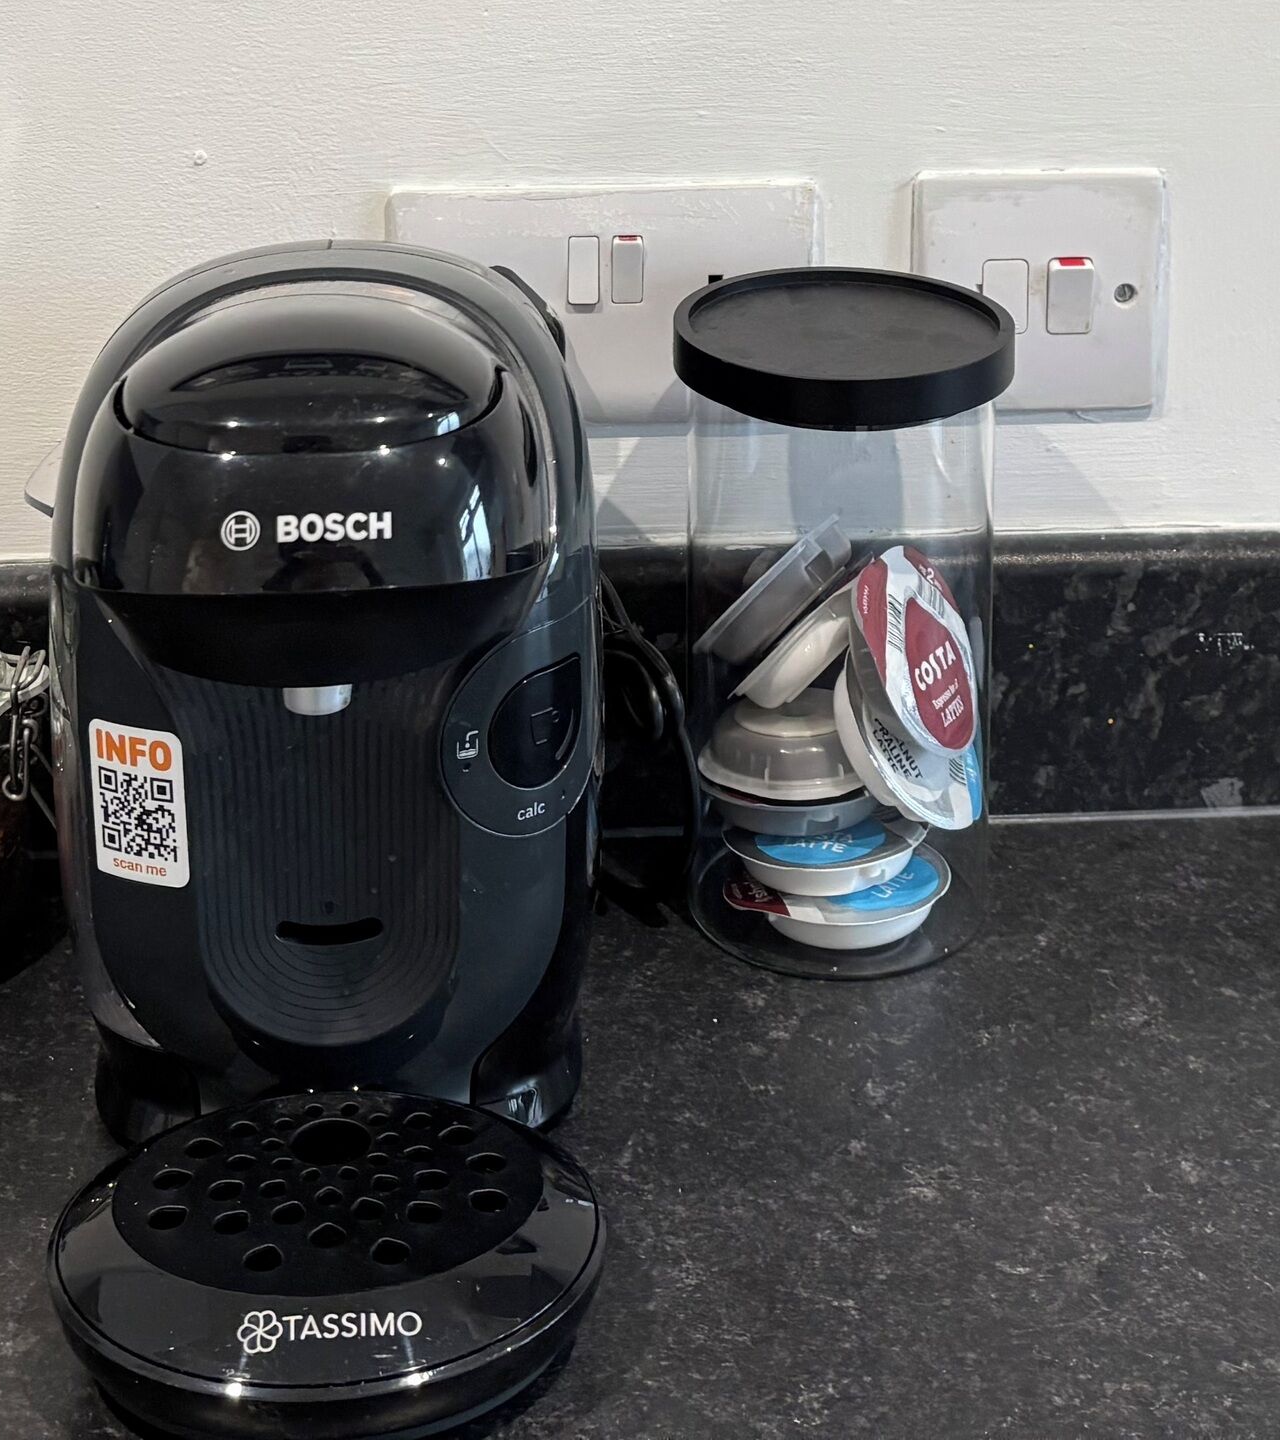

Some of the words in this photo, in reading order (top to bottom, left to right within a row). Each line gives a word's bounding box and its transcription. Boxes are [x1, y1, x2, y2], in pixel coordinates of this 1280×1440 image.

[276, 511, 393, 544] BOSCH
[914, 640, 957, 691] COSTA
[95, 727, 173, 772] INFO
[517, 801, 546, 821] calc
[112, 857, 143, 873] scan
[146, 864, 167, 877] me
[871, 869, 915, 899] LATTE
[281, 1310, 423, 1342] TASSIMO
